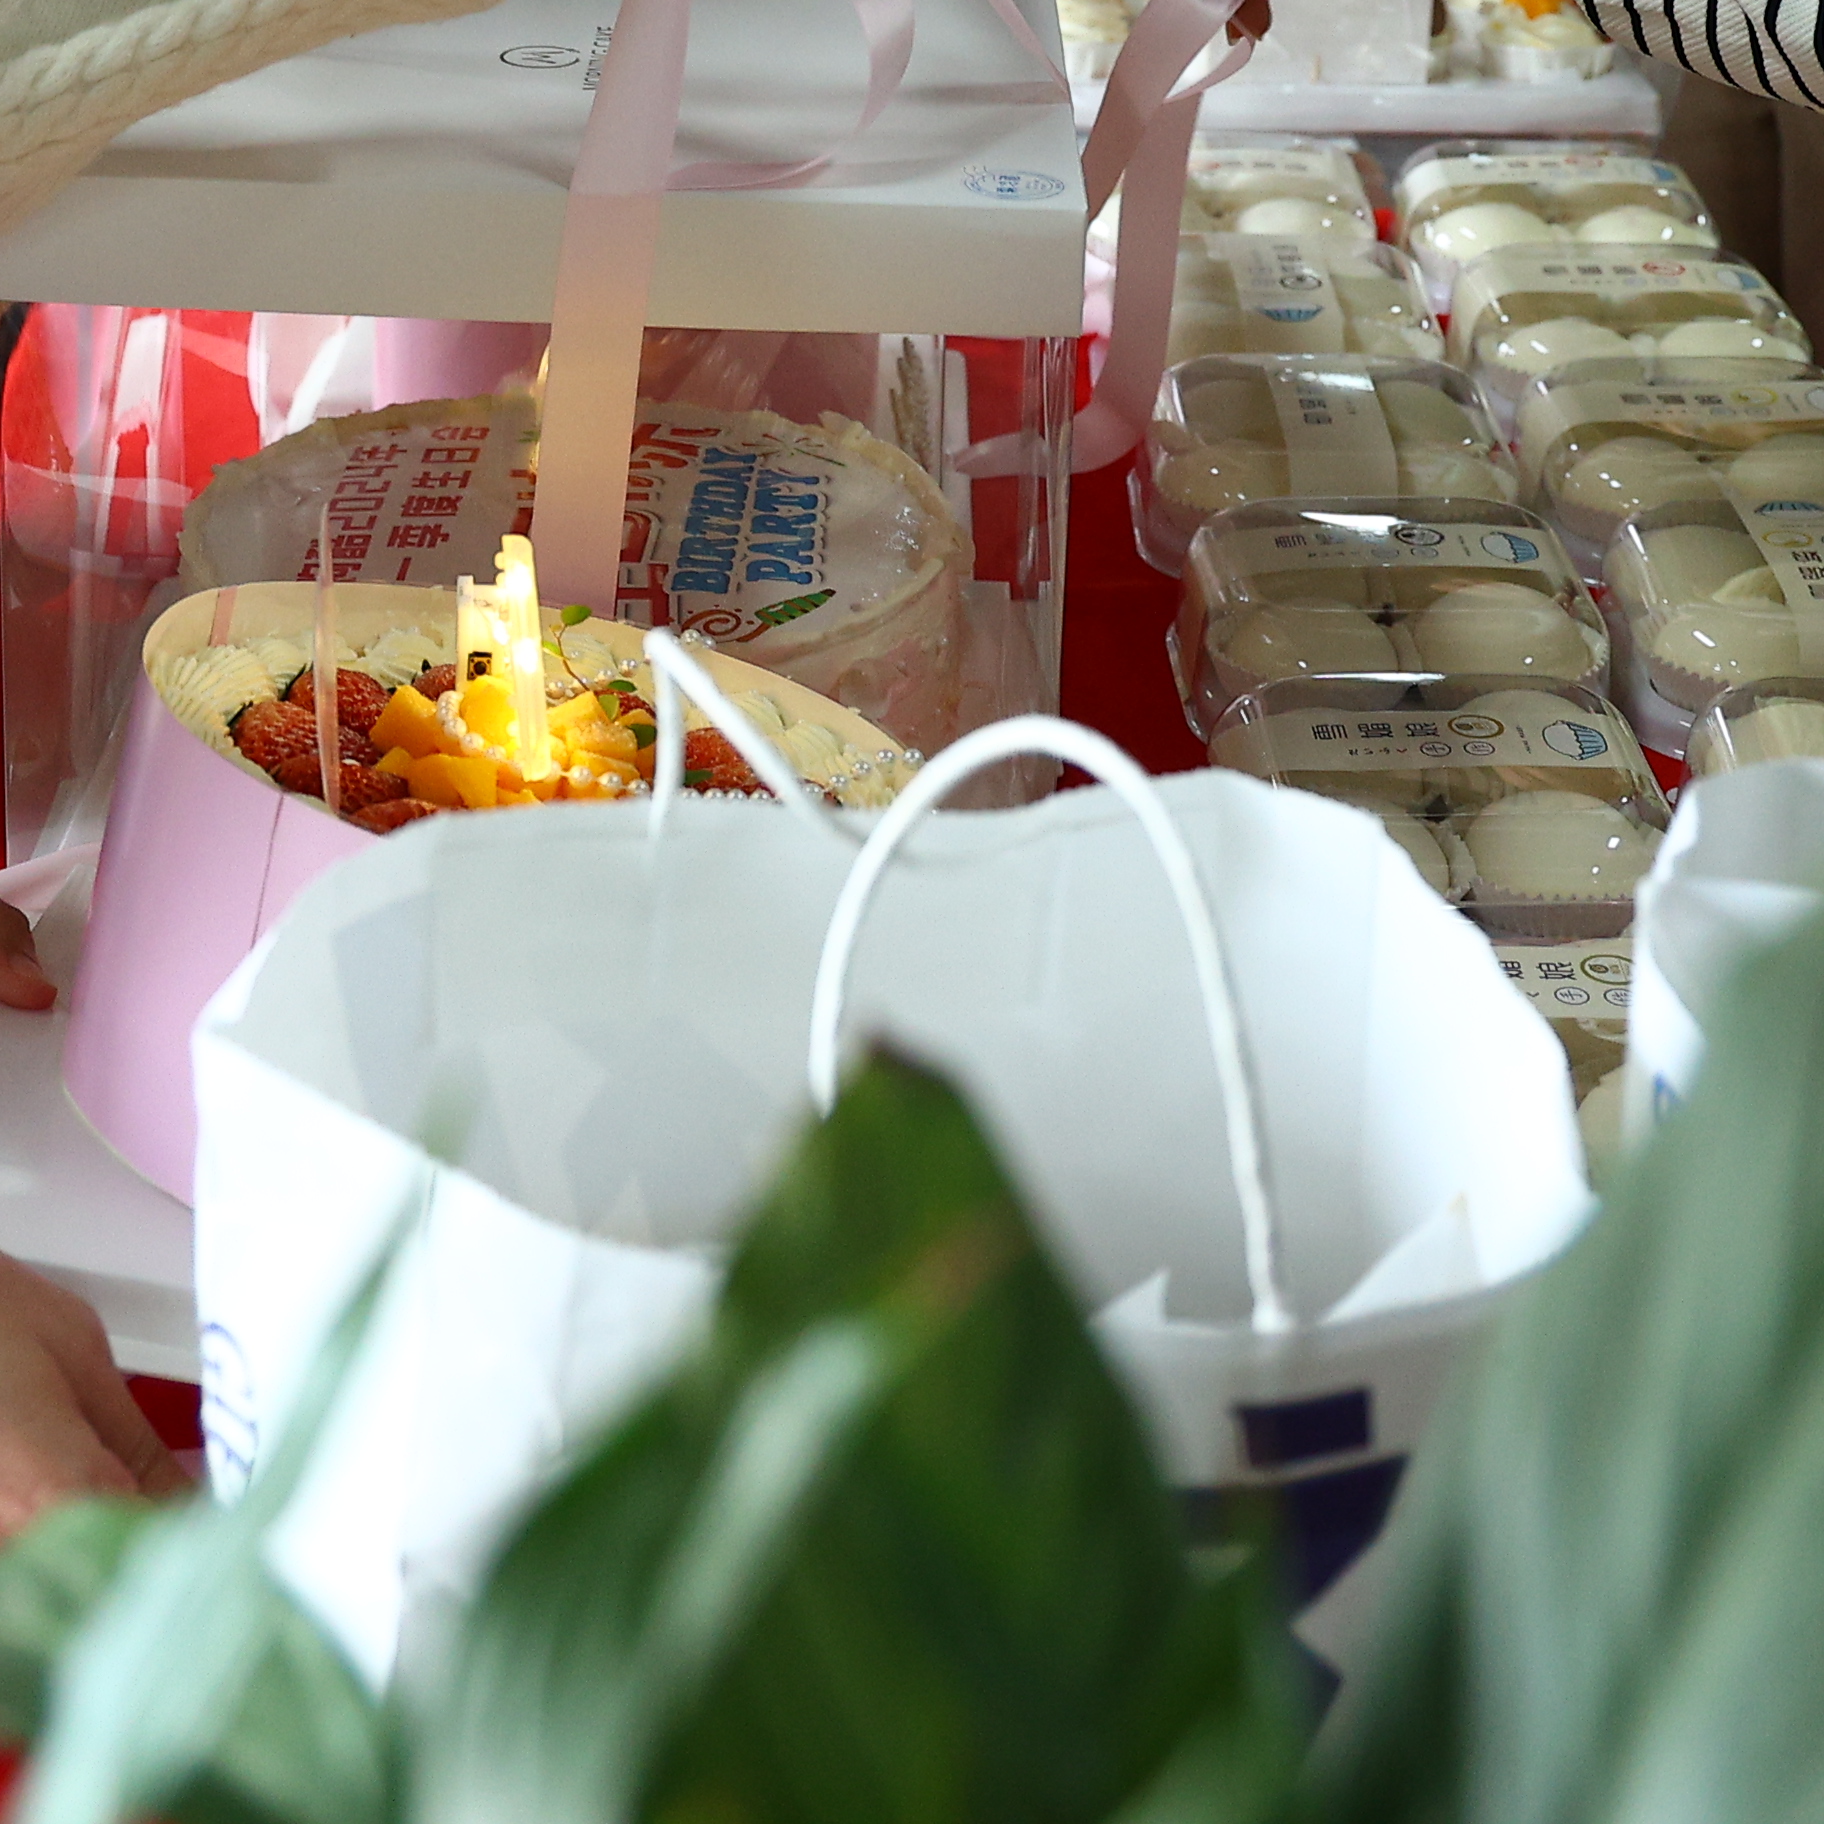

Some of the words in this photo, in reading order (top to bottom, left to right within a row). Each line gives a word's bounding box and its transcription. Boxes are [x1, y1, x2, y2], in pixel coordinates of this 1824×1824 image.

[386, 426, 491, 582] 一季度生日会
[670, 447, 759, 595] BIRTHDAY
[744, 468, 821, 586] PARTY
[1310, 721, 1442, 741] 雪媚娘
